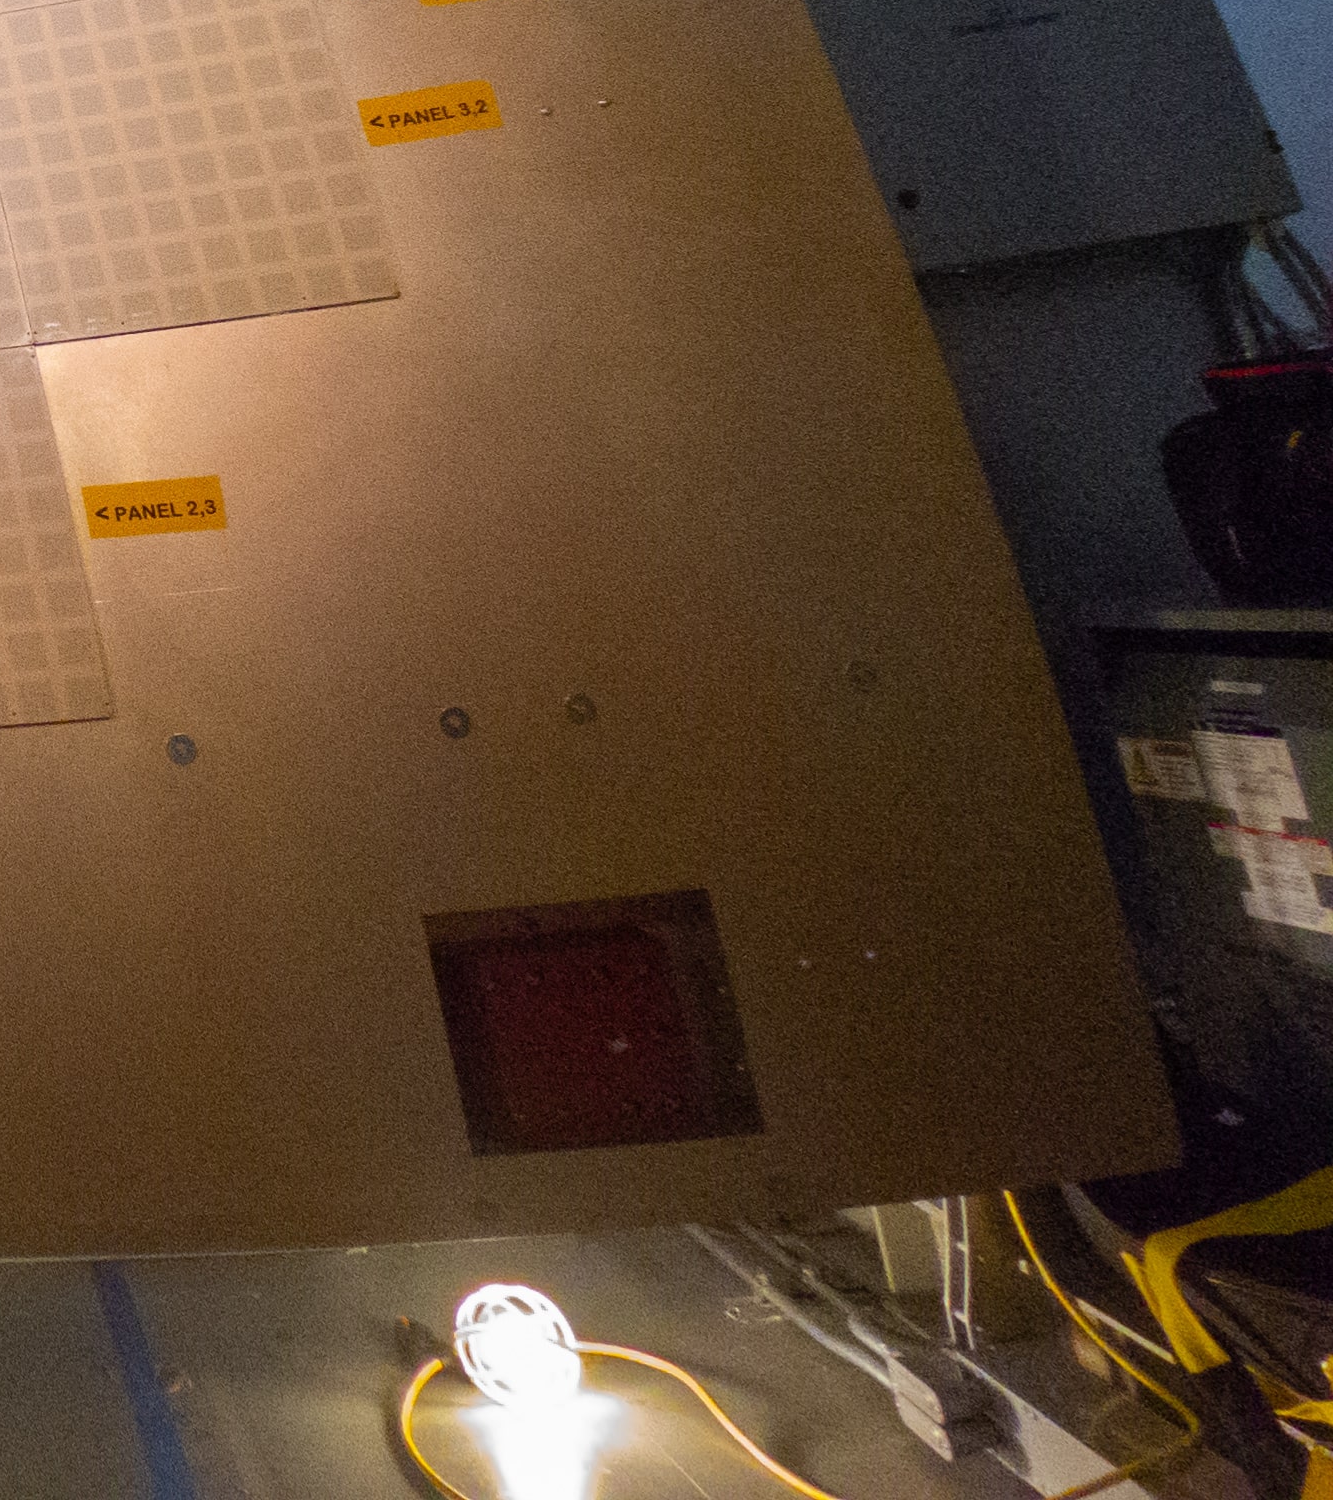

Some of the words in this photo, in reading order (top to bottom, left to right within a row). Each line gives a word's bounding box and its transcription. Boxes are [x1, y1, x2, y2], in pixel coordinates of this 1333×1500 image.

[388, 106, 455, 128] PANEL
[458, 99, 489, 117] 3,2
[114, 501, 183, 521] PANEL
[186, 499, 217, 518] 2,3
